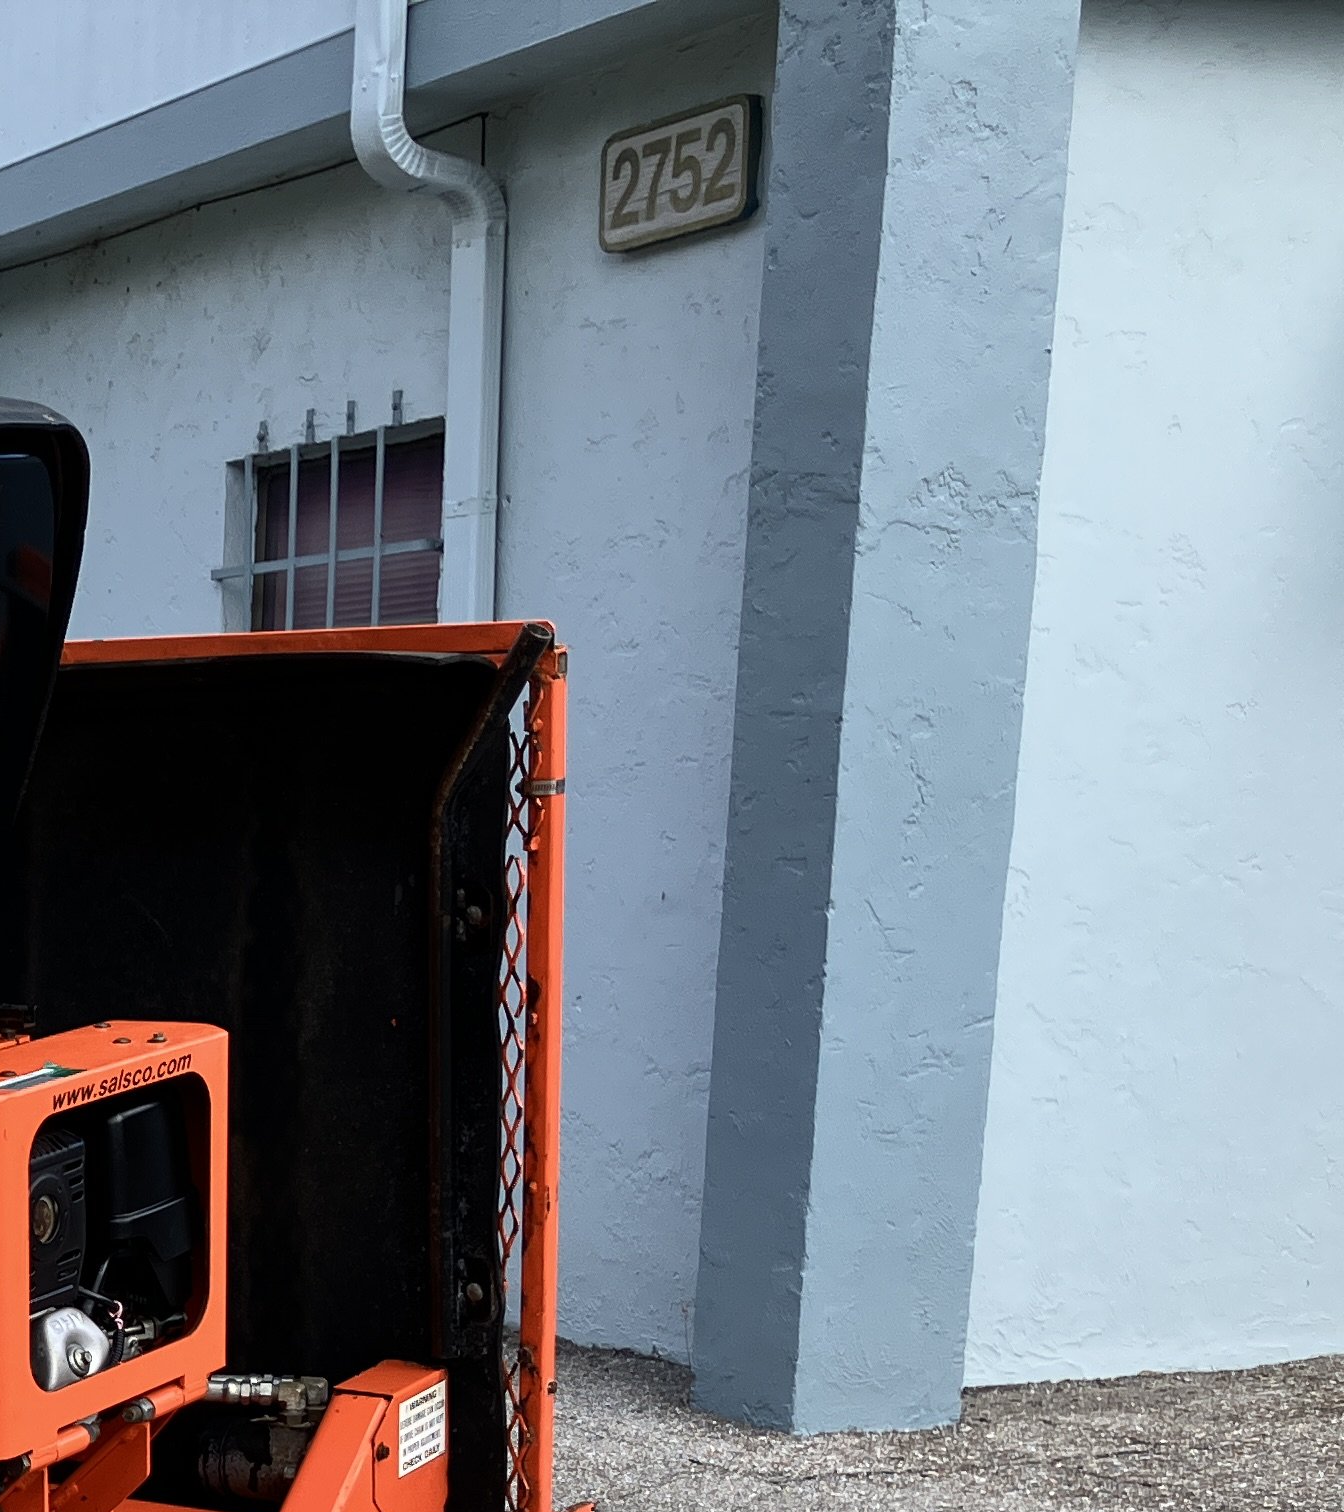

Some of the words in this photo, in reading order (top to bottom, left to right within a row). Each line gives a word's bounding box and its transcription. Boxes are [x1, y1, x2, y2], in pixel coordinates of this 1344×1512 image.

[611, 118, 736, 230] 2752
[52, 1053, 192, 1112] www.salsco.com
[409, 1390, 437, 1411] WARNING
[403, 1454, 423, 1471] CHECK
